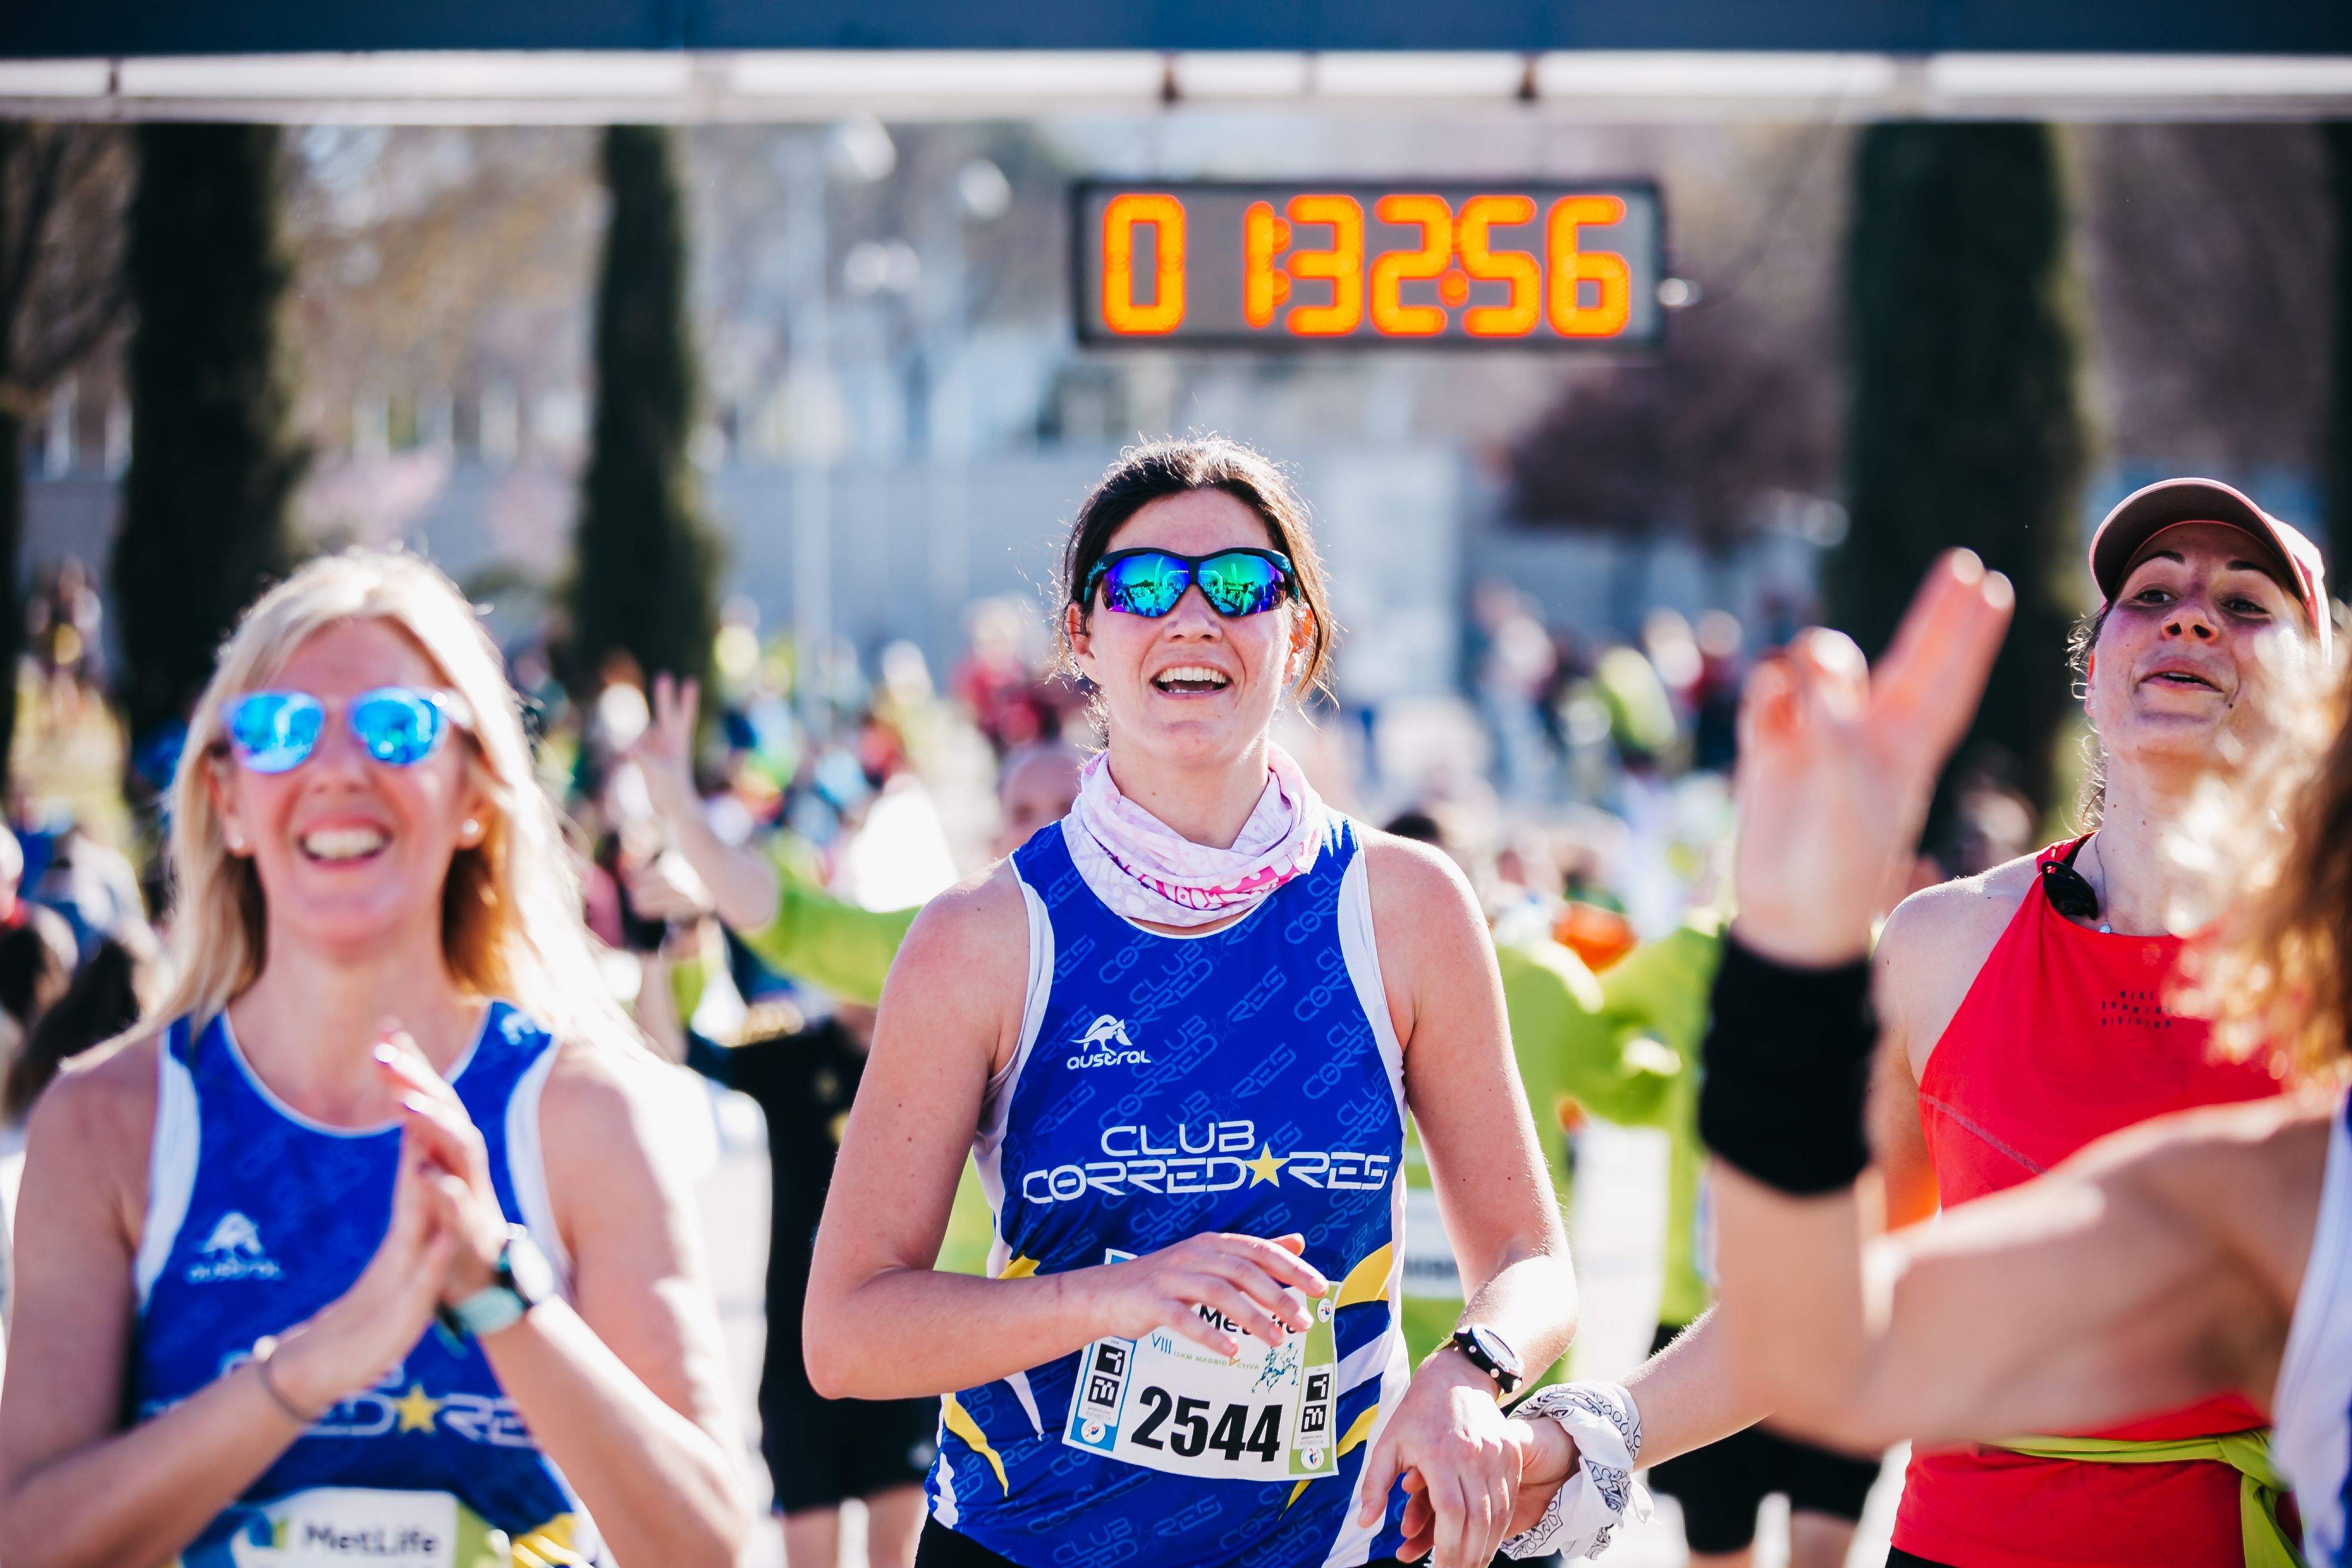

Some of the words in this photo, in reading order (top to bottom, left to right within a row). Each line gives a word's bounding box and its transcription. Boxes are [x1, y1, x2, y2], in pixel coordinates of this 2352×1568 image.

[1102, 194, 1186, 335] 0
[1308, 864, 1344, 897] CL
[1284, 889, 1338, 945] COR
[1053, 935, 1096, 985] ES
[1118, 958, 1213, 1048] ORRED
[1294, 965, 1348, 1022] COR
[1067, 1050, 1151, 1070] austral
[1303, 1024, 1375, 1099] CORR
[1101, 1119, 1255, 1157] CLUB
[1152, 1333, 1172, 1355] VIII
[1195, 1357, 1228, 1367] MADRID
[1131, 1386, 1283, 1462] 2544
